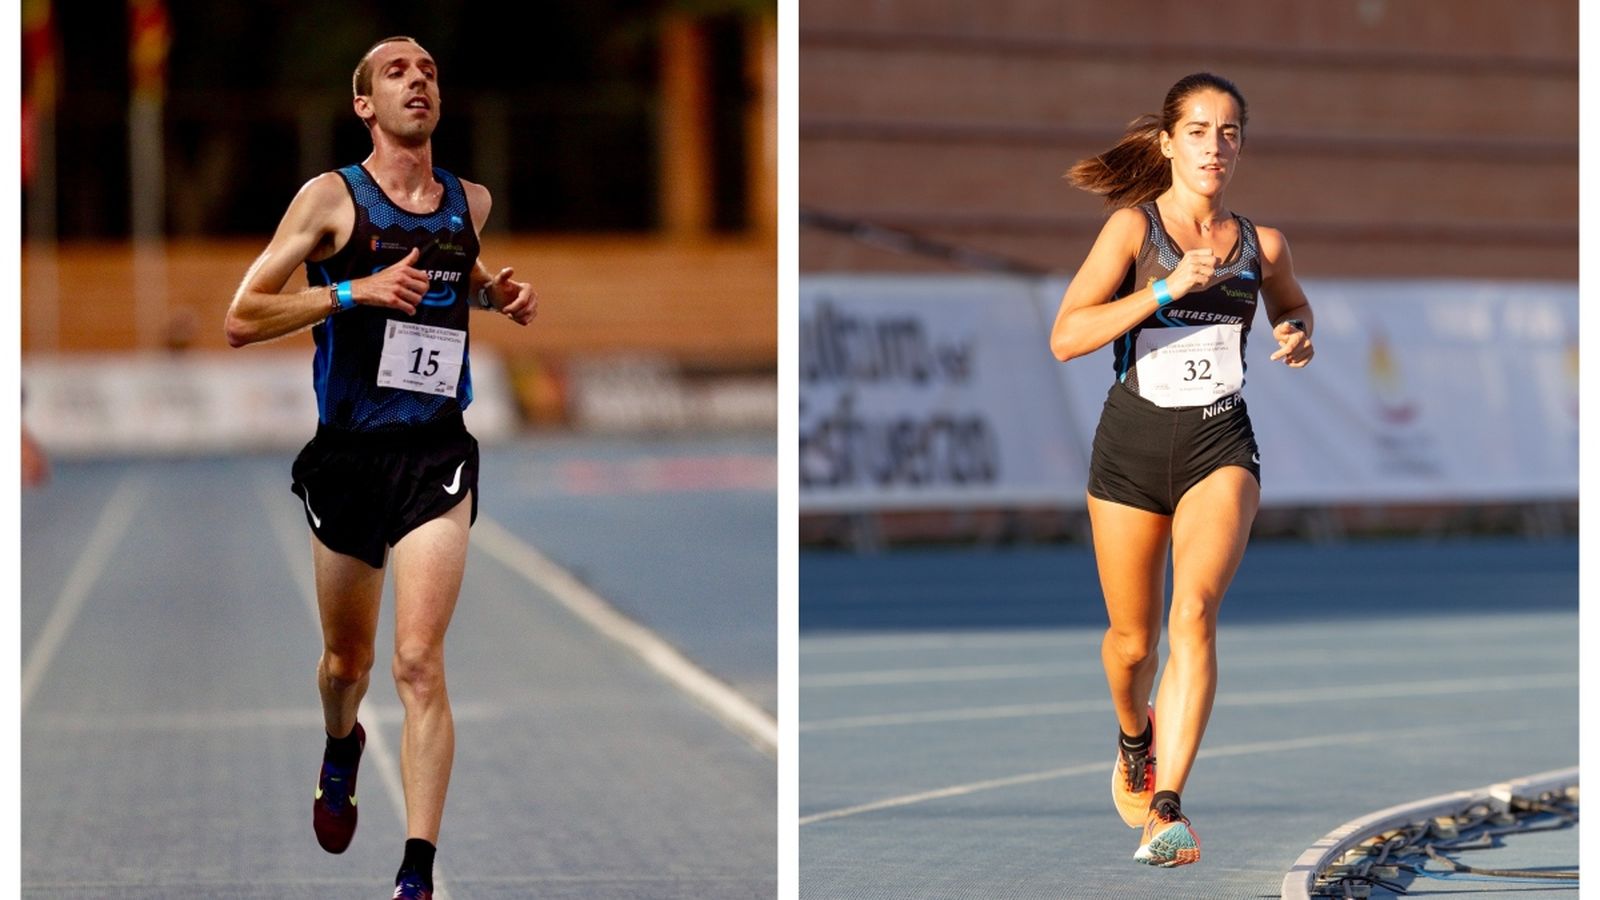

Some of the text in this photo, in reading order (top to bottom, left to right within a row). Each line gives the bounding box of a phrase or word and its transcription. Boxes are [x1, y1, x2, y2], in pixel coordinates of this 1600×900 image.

[427, 270, 462, 282] SPORT
[1167, 309, 1242, 324] METAESPORT
[409, 347, 440, 377] 15
[1183, 359, 1212, 381] 32
[1202, 397, 1233, 420] NIKE
